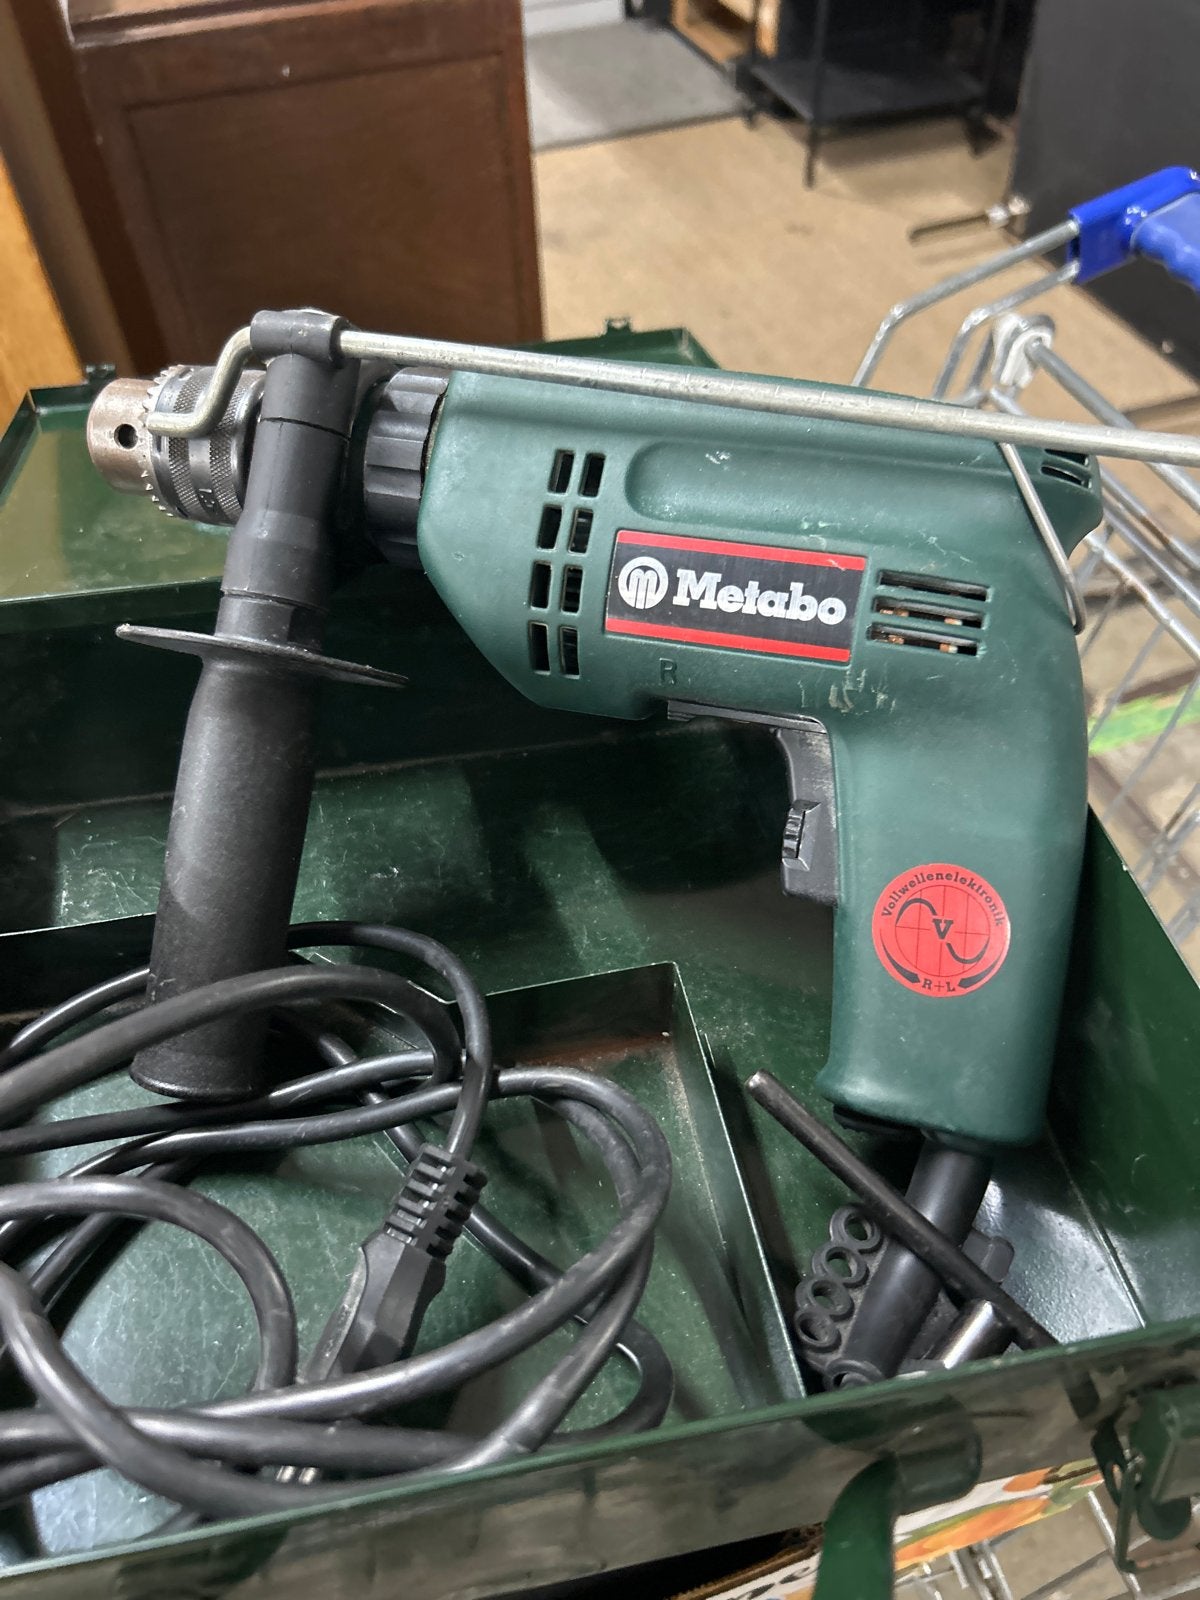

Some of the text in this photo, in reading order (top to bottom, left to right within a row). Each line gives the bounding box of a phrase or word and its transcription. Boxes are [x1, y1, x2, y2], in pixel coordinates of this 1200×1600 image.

[672, 568, 847, 625] Metabo
[659, 657, 677, 685] R
[881, 871, 1006, 927] Vollwellenelektronik
[932, 918, 954, 939] V
[921, 978, 956, 992] R+L
